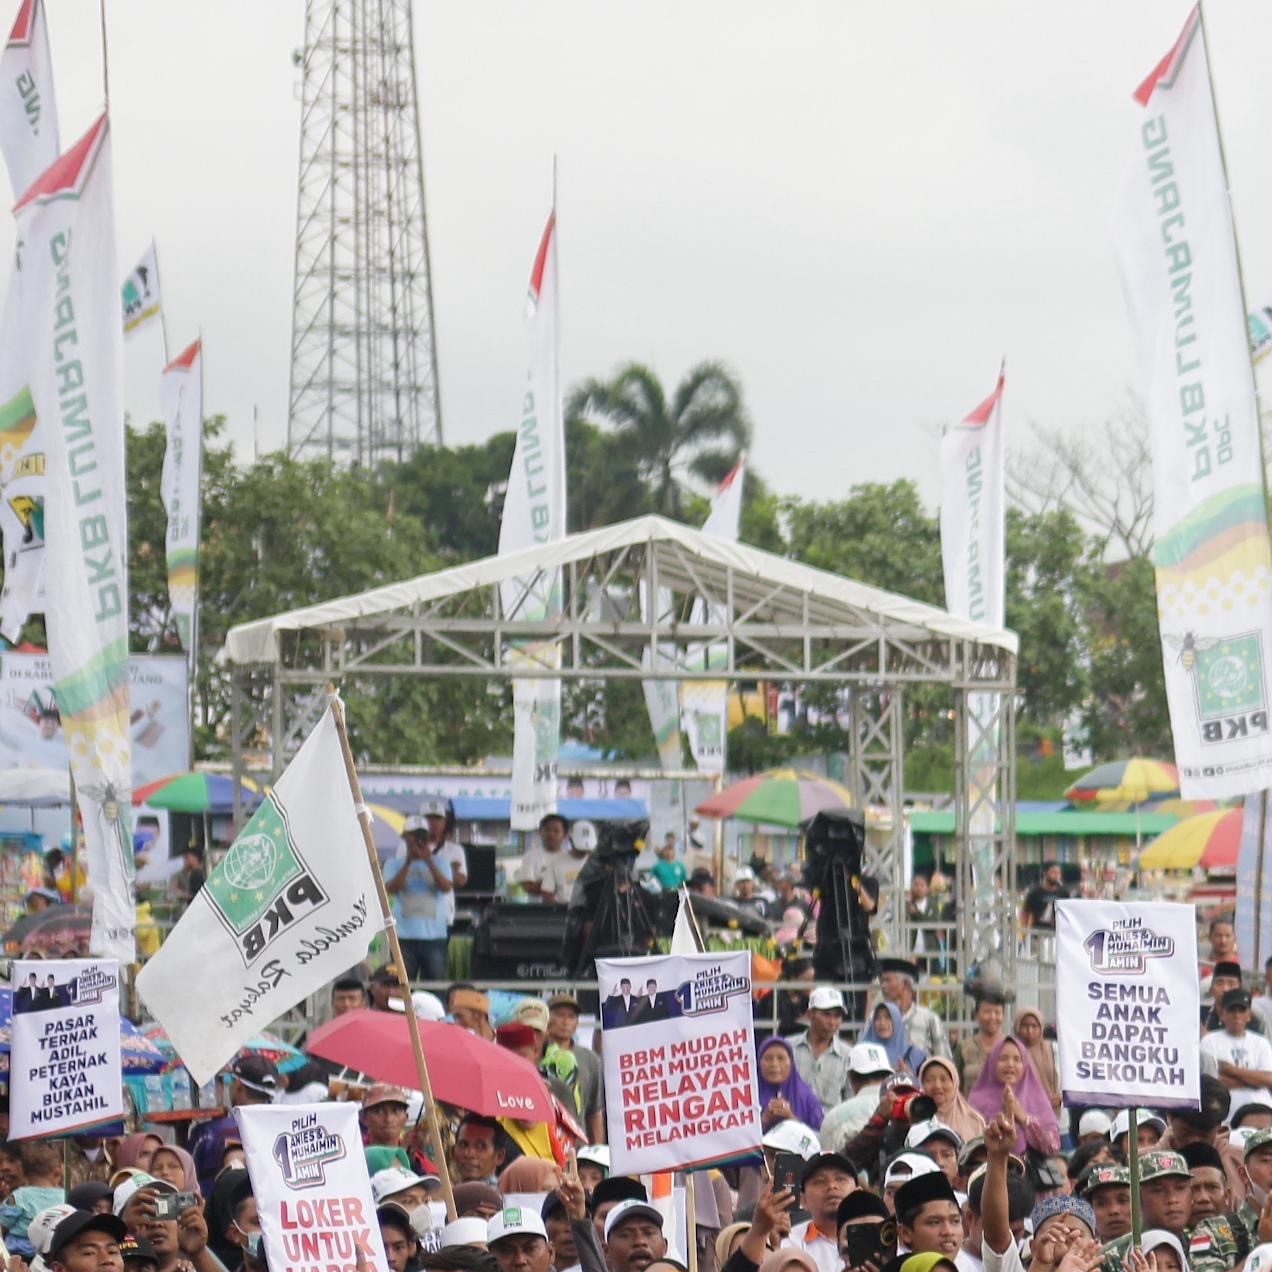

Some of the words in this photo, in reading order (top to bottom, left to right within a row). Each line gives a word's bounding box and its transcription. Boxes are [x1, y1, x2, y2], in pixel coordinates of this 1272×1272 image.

[1112, 917, 1142, 930] PILIH
[1107, 937, 1167, 951] MUHAIMIN
[1108, 931, 1139, 942] ANIES
[696, 966, 721, 980] PILIH
[1109, 956, 1139, 969] AMIN
[694, 976, 720, 991] ANIES
[694, 978, 743, 996] MUHAIMIN
[1088, 981, 1171, 1005] SEMUA
[696, 998, 722, 1010] AMIN
[1096, 1002, 1162, 1025] ANAK
[44, 1014, 95, 1035] PASAR
[1091, 1022, 1169, 1045] DAPAT
[38, 1026, 99, 1050] TERNAK
[619, 1046, 665, 1070] BBM
[670, 1028, 748, 1058] MUDAH
[1081, 1041, 1179, 1066] BANGKU
[29, 1052, 108, 1081] PETERNAK
[620, 1063, 664, 1086] DAN
[668, 1046, 749, 1076] MURAH,
[1076, 1061, 1185, 1086] SEKOLAH
[49, 1071, 87, 1091] KAYA
[622, 1062, 751, 1107] NELAYAN
[43, 1083, 95, 1107] BUKAN
[497, 1091, 535, 1111] Love
[30, 1096, 109, 1124] MUSTAHIL
[624, 1084, 753, 1133] RINGAN
[291, 1112, 317, 1133] PILIH
[626, 1110, 754, 1150] MELANGKAH
[290, 1131, 315, 1148] ANIES
[291, 1136, 337, 1159] MUHAIMIN
[296, 1163, 320, 1179] AMIN
[280, 1197, 366, 1230] LOKER
[282, 1229, 377, 1263] UNTUK
